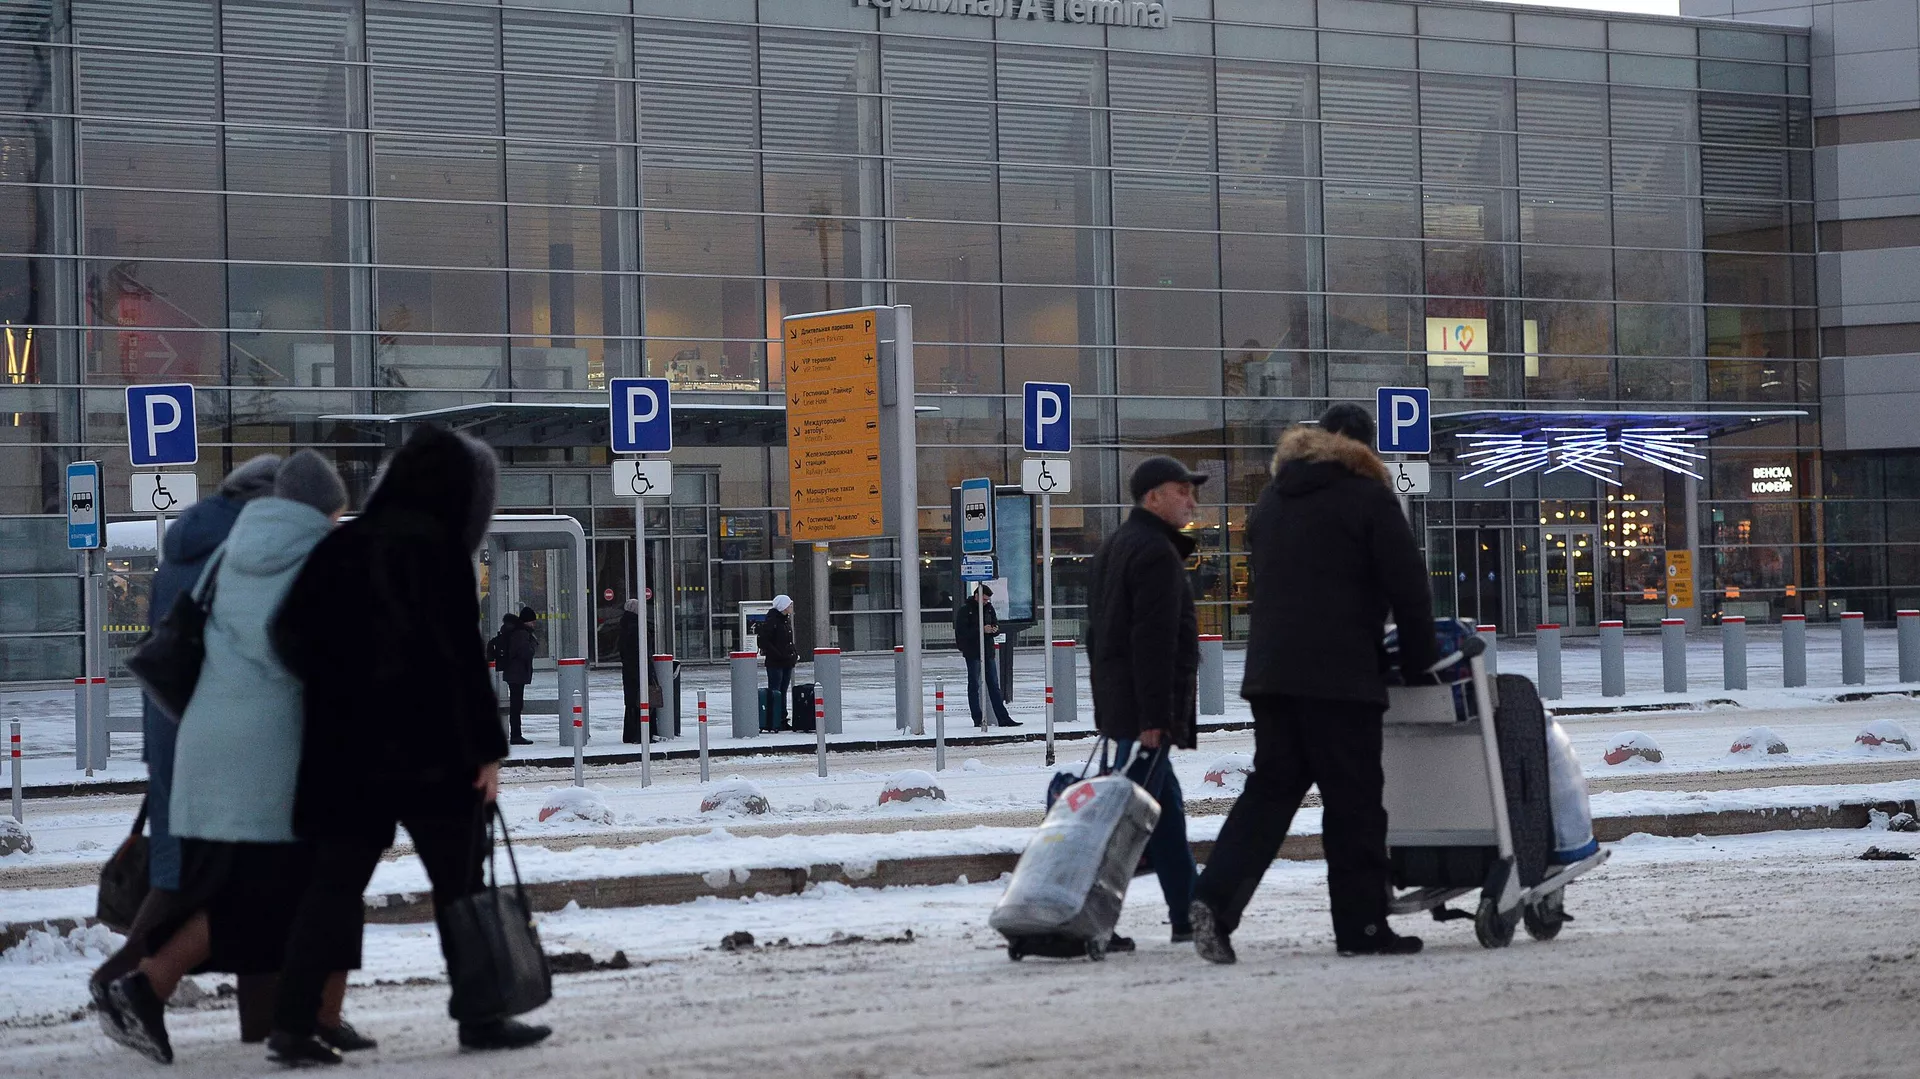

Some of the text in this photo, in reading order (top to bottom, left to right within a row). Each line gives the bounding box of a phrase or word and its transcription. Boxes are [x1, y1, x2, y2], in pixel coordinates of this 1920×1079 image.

[145, 395, 181, 457] P
[627, 387, 658, 444] P
[1036, 391, 1062, 443] P
[1391, 395, 1420, 446] P
